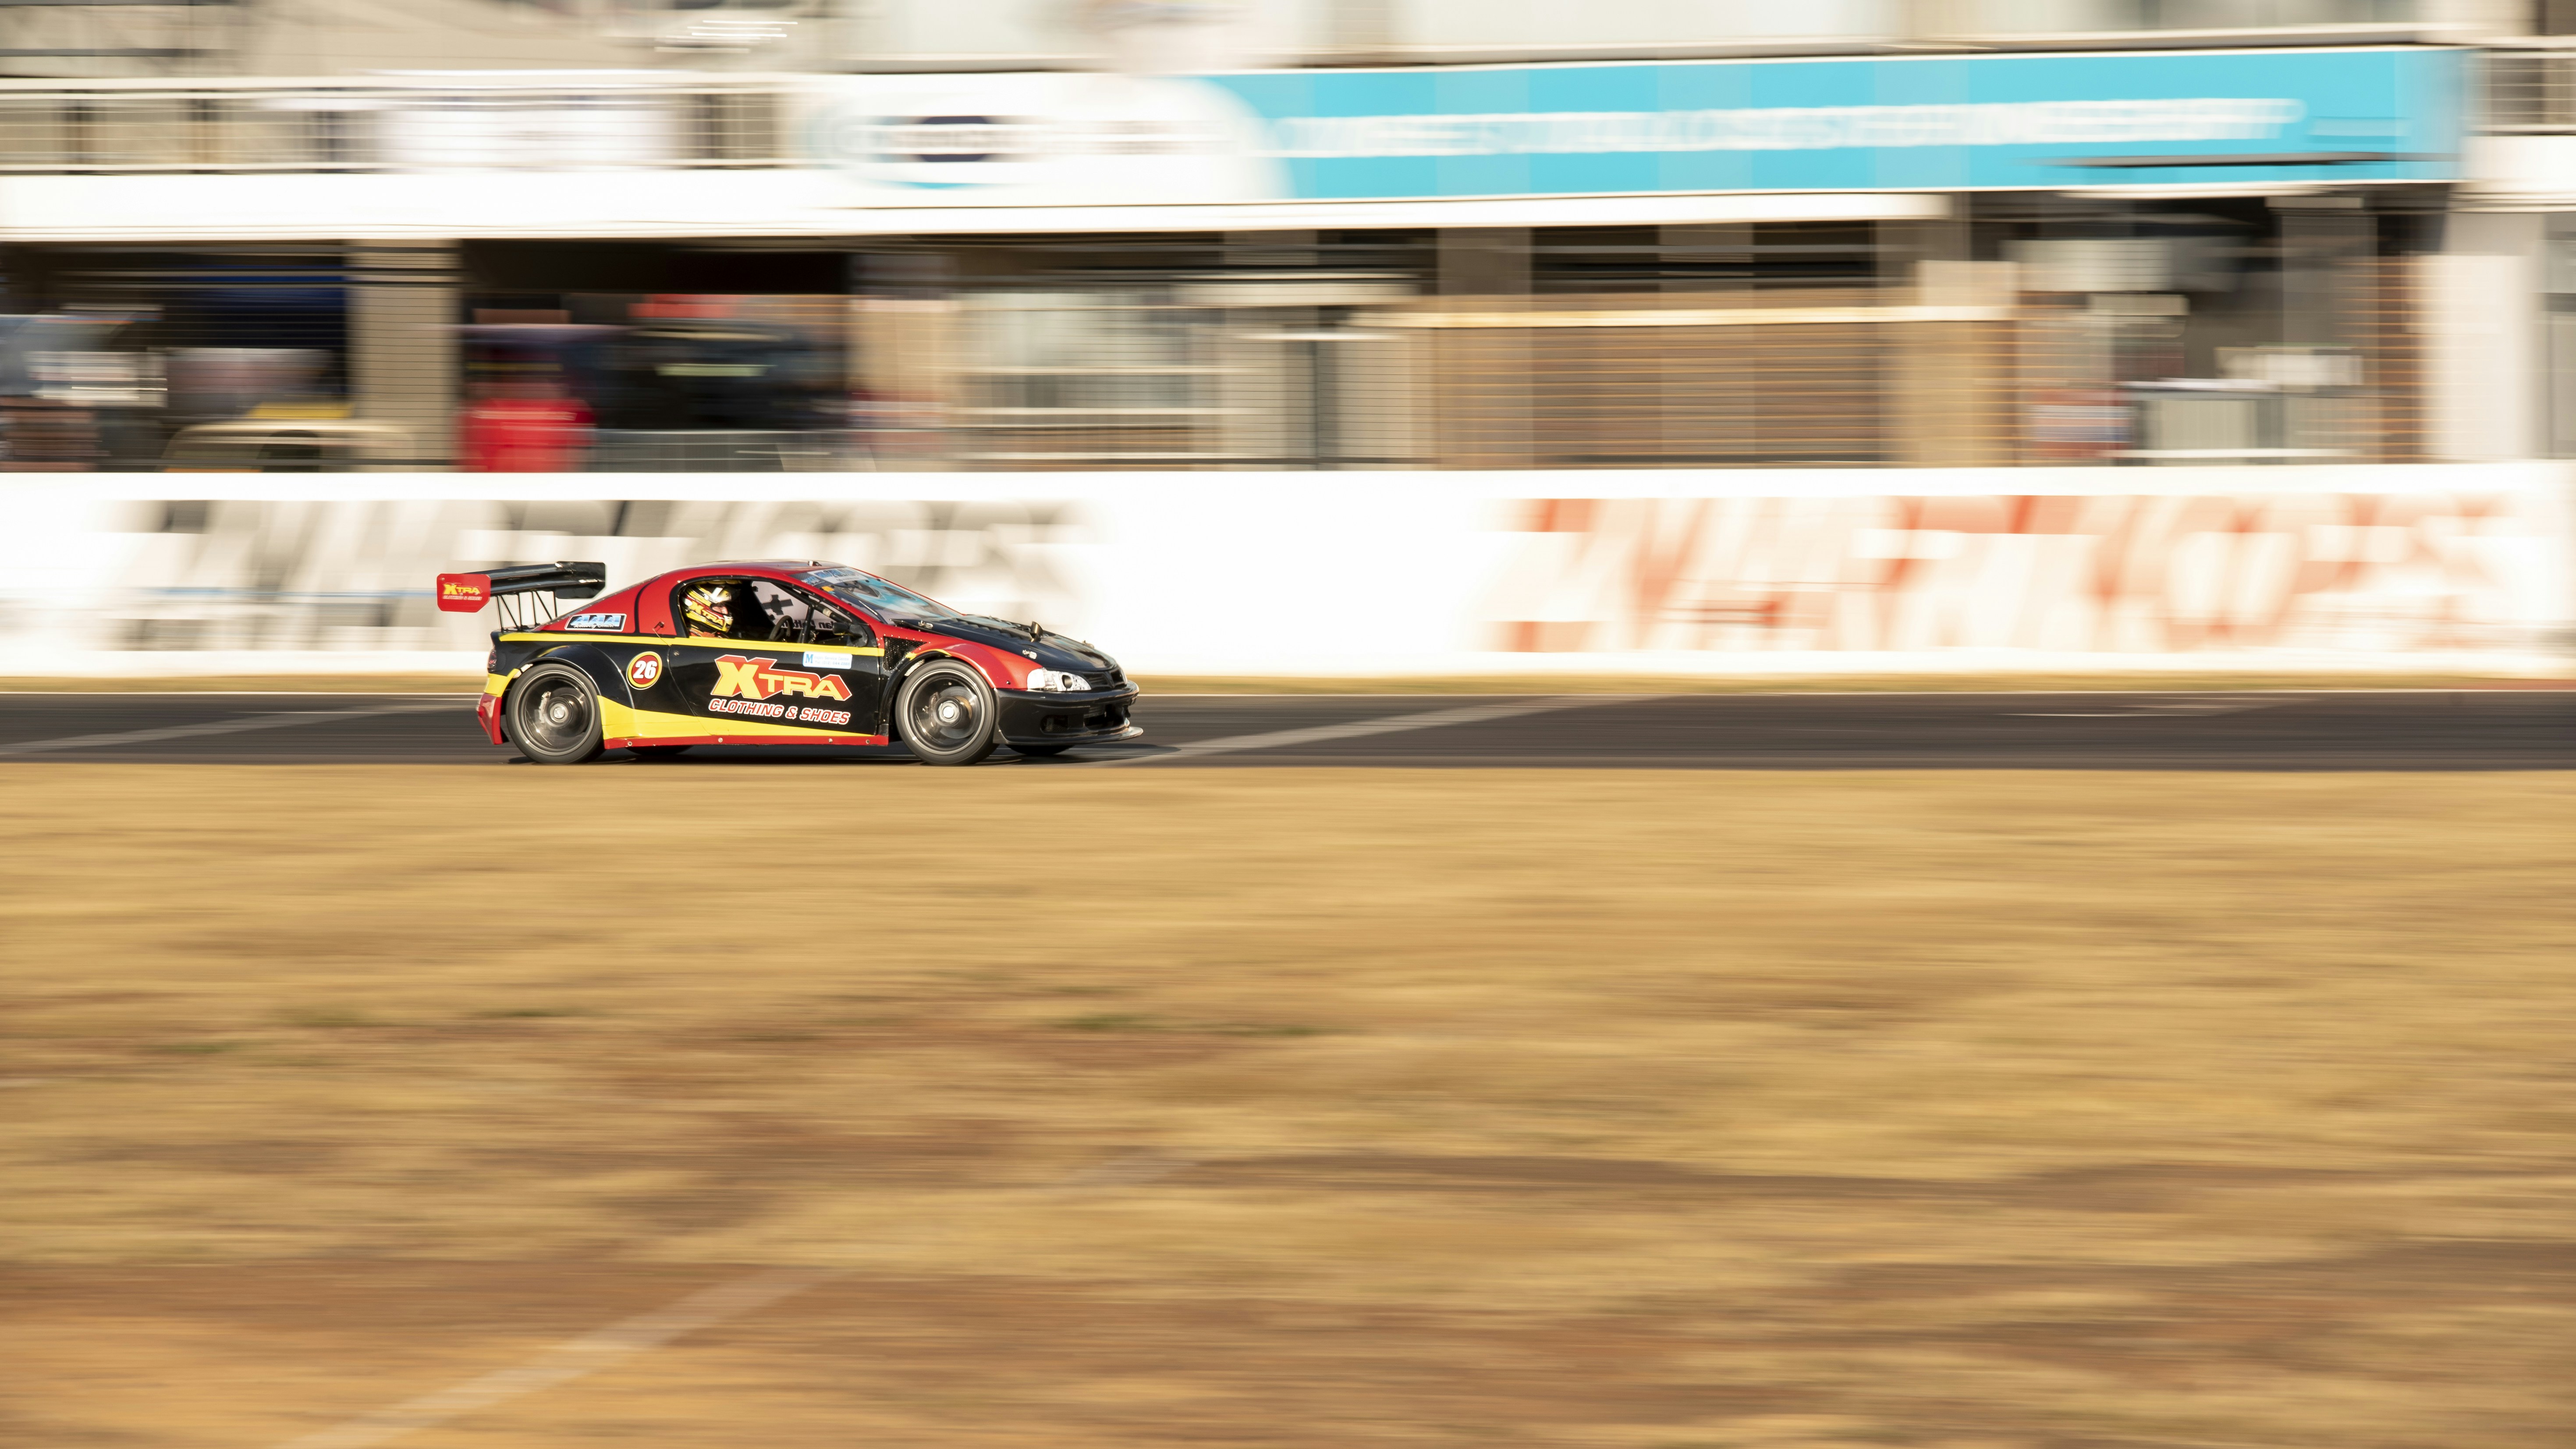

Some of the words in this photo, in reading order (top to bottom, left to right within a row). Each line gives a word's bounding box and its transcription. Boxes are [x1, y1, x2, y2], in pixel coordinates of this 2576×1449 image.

[443, 583, 482, 595] XTRA
[570, 615, 621, 627] AAA
[689, 600, 724, 626] XTRA
[805, 654, 813, 663] M
[633, 660, 657, 679] 26
[711, 656, 849, 700] XTRA
[709, 699, 784, 717] CLOTHING
[785, 706, 798, 720] &
[799, 707, 851, 725] SHOES
